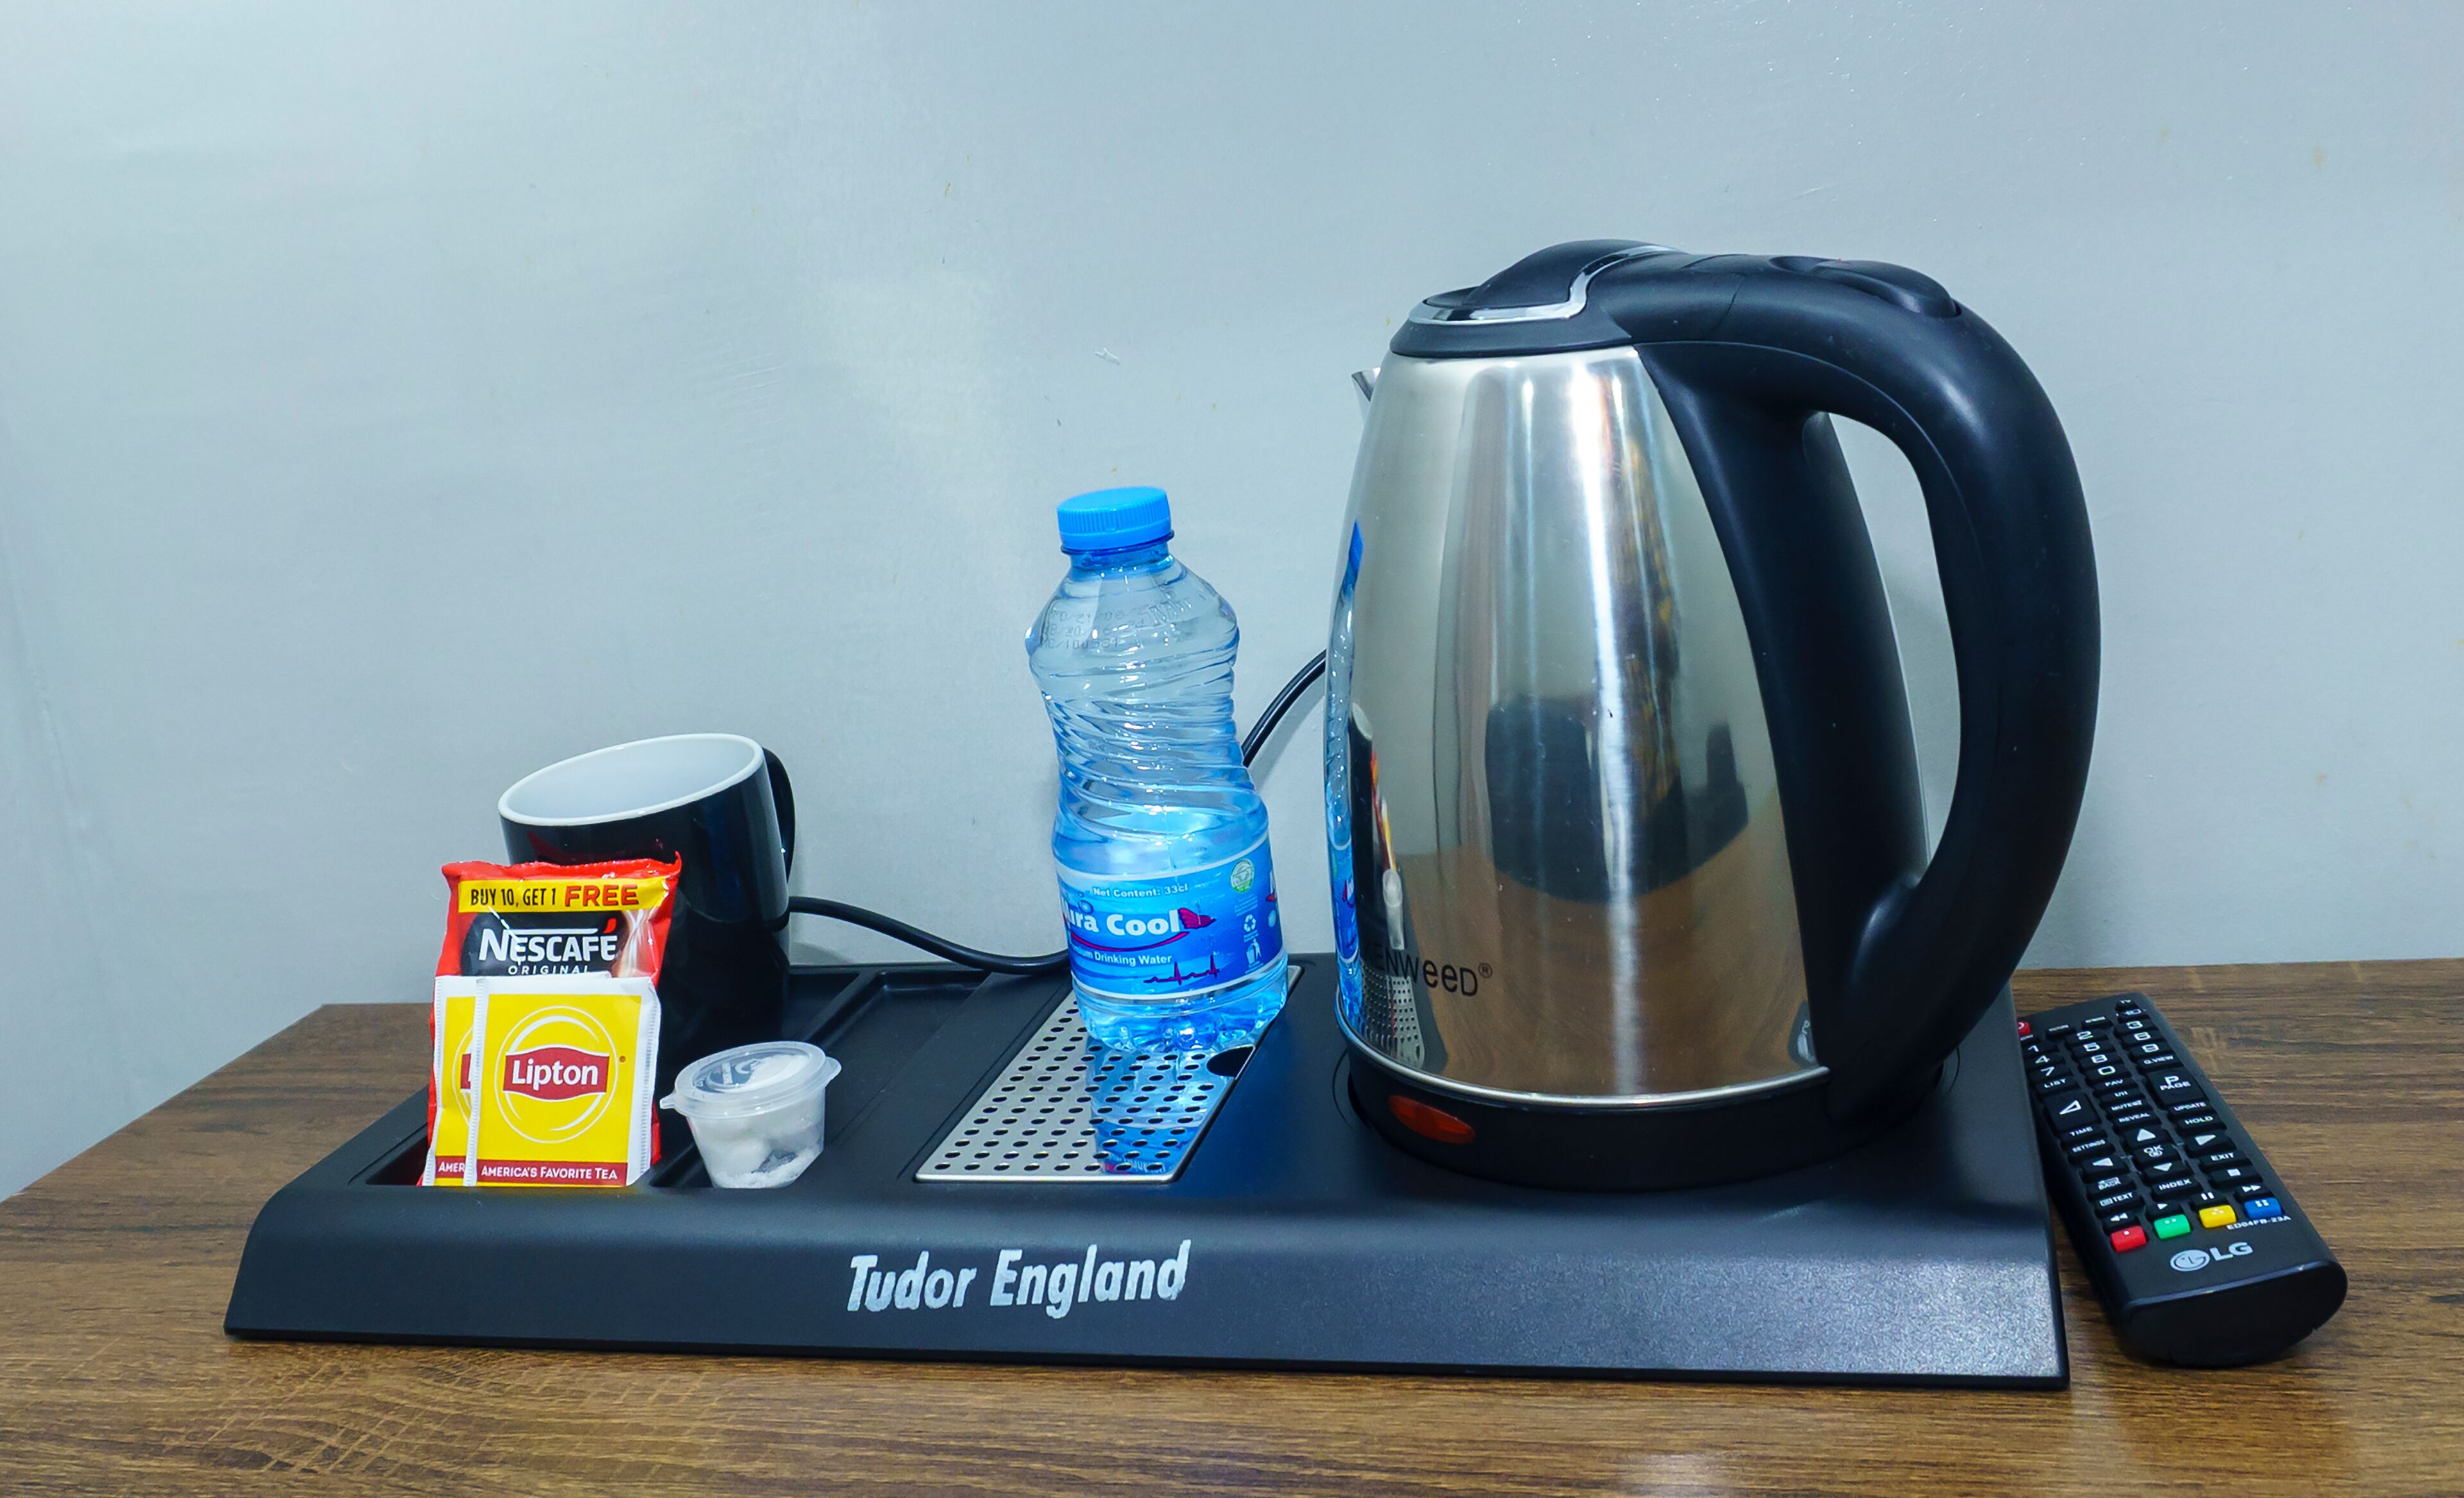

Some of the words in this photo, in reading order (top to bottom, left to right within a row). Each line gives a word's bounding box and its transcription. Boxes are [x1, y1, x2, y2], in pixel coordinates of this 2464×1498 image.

[470, 889, 496, 905] BUY
[501, 889, 518, 907] 10,
[523, 889, 549, 906] GET
[551, 888, 556, 905] 1
[565, 884, 639, 906] FREE
[1093, 887, 1110, 896] Net
[1113, 888, 1161, 898] Content:
[1165, 883, 1188, 894] 33cl
[1106, 909, 1179, 936] Cool
[1094, 951, 1136, 967] Drinking
[1138, 955, 1172, 965] Water
[2076, 1030, 2094, 1040] 2
[2028, 1044, 2039, 1053] 1
[2083, 1042, 2100, 1052] 5
[2035, 1055, 2050, 1064] 4
[2091, 1054, 2108, 1064] 8
[511, 1058, 598, 1091] Lipton
[2041, 1066, 2055, 1077] 7
[2044, 1078, 2066, 1089] LIST
[2105, 1079, 2124, 1087] FAV
[2164, 1075, 2180, 1085] P
[2159, 1081, 2191, 1091] PAGE
[2173, 1102, 2207, 1111] UPDATE
[2118, 1112, 2150, 1123] REVEAL
[2184, 1116, 2214, 1125] HOLD
[2069, 1127, 2094, 1137] TIME
[2072, 1139, 2106, 1153] SETTINGS
[2143, 1145, 2164, 1153] OK
[2211, 1152, 2235, 1161] EXIT
[481, 1164, 537, 1178] AMERICA'S
[540, 1166, 592, 1179] FAVORITE
[595, 1168, 618, 1180] TEA
[2098, 1180, 2121, 1190] BACK
[2159, 1179, 2192, 1191] INDEX
[2112, 1191, 2134, 1202] TEXT
[2209, 1241, 2254, 1261] LG
[847, 1250, 977, 1312] Tudor
[989, 1239, 1192, 1320] England
